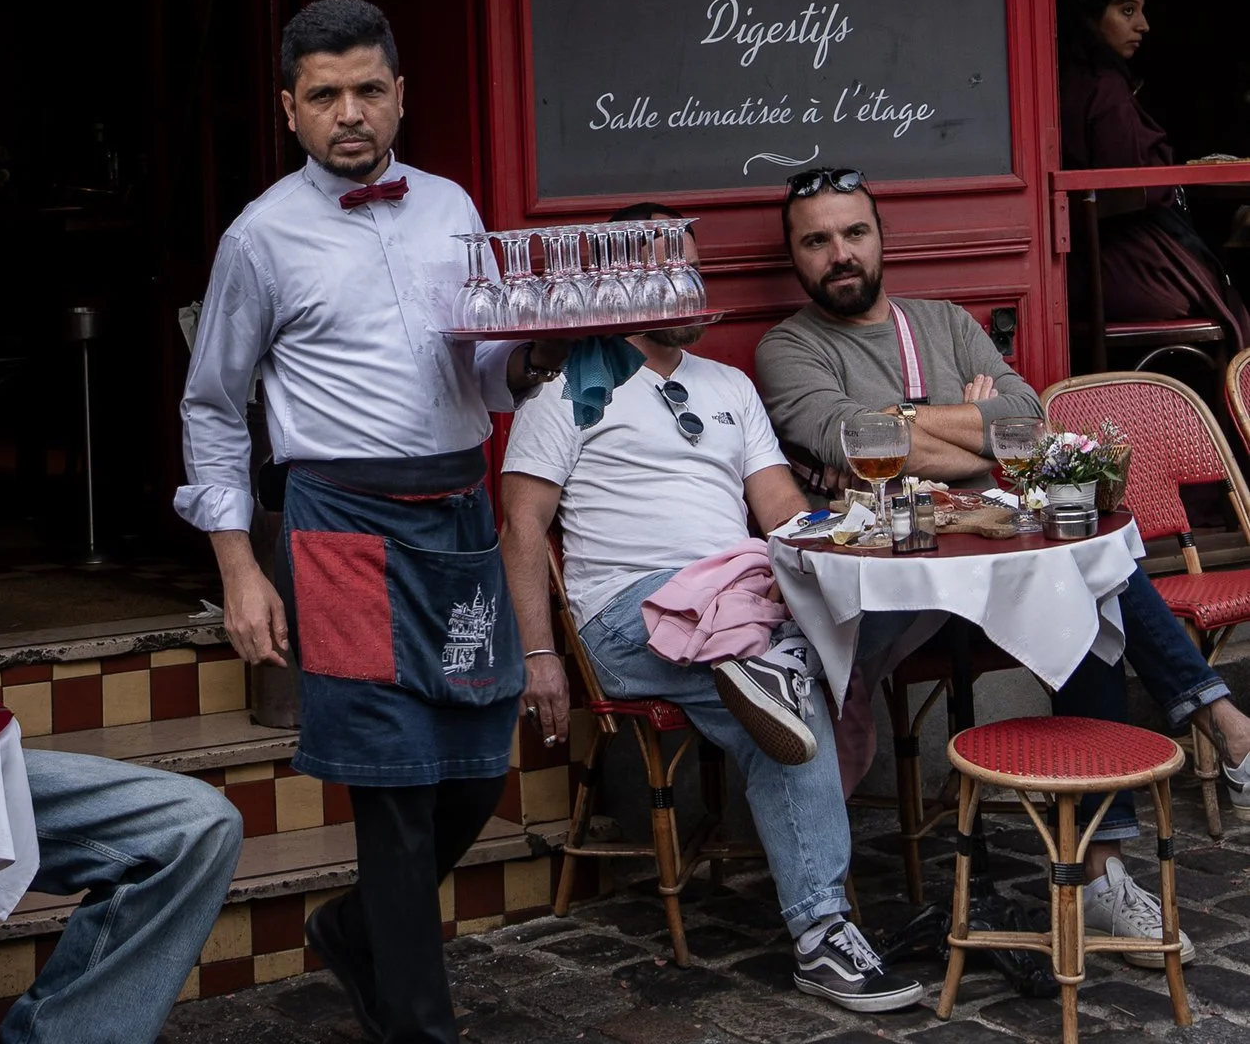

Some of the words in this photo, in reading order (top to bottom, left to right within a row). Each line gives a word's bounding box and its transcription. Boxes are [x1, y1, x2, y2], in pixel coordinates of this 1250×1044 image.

[589, 92, 661, 131] Salle
[667, 94, 796, 127] climatisée
[802, 97, 824, 124] à
